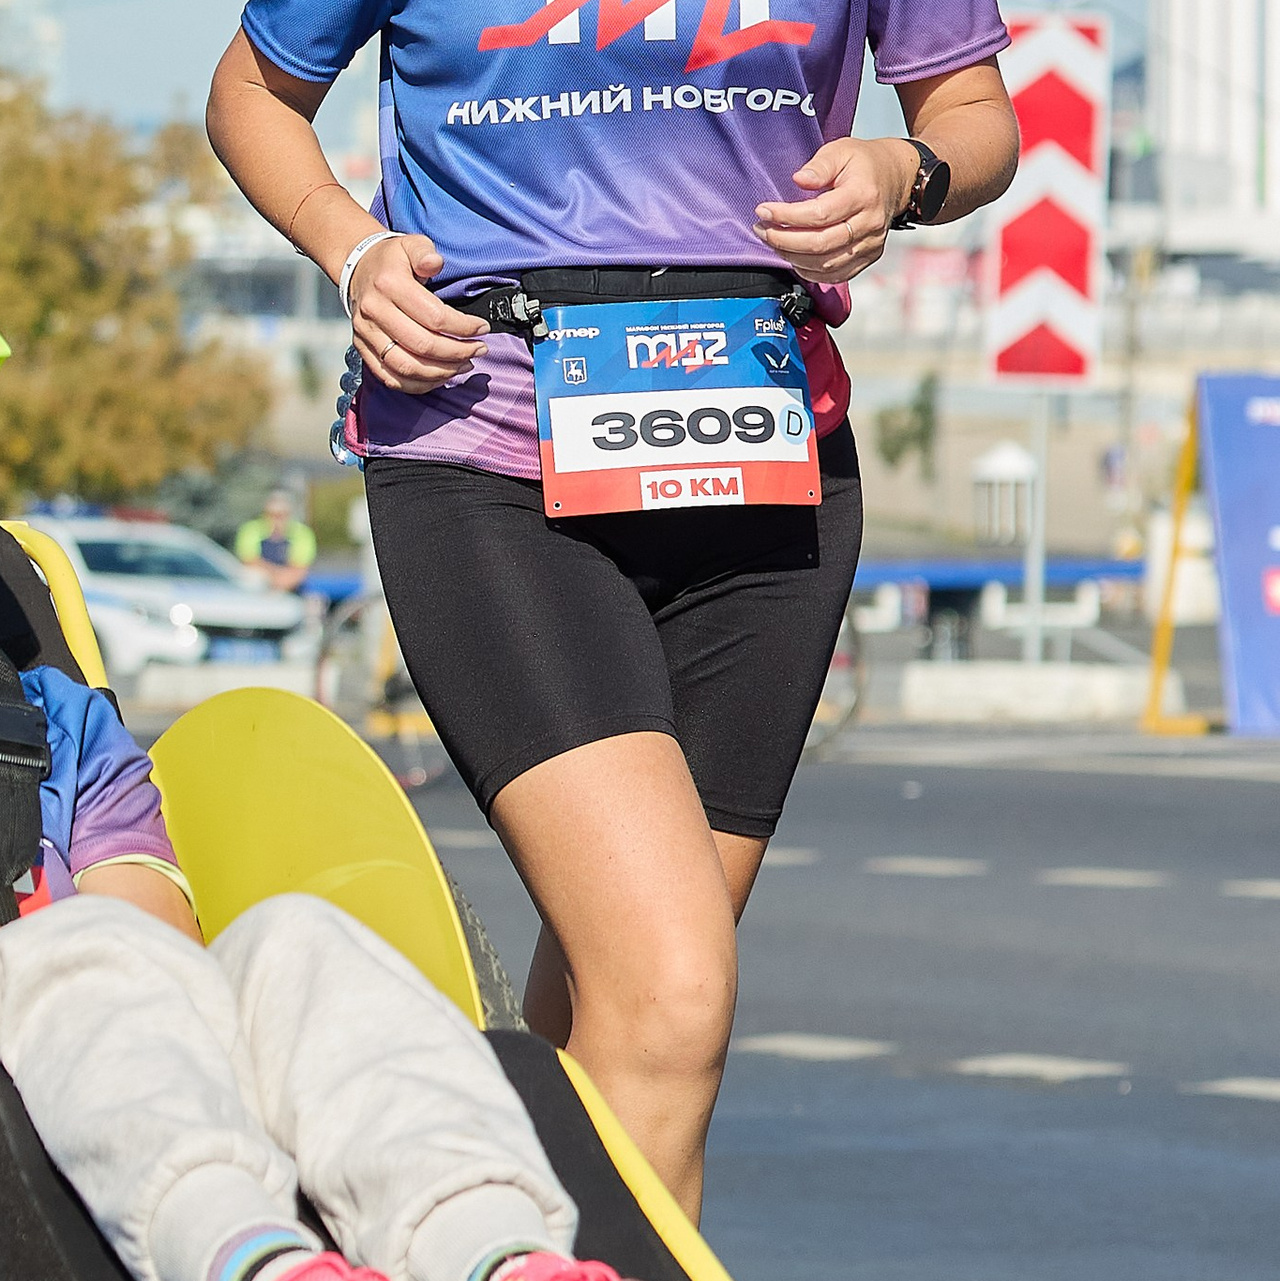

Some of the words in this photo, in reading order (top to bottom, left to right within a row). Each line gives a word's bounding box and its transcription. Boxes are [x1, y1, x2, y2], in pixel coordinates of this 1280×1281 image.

[446, 83, 634, 127] НИЖНИЙ
[591, 405, 776, 451] 3609
[786, 409, 804, 437] D
[646, 479, 683, 500] 10
